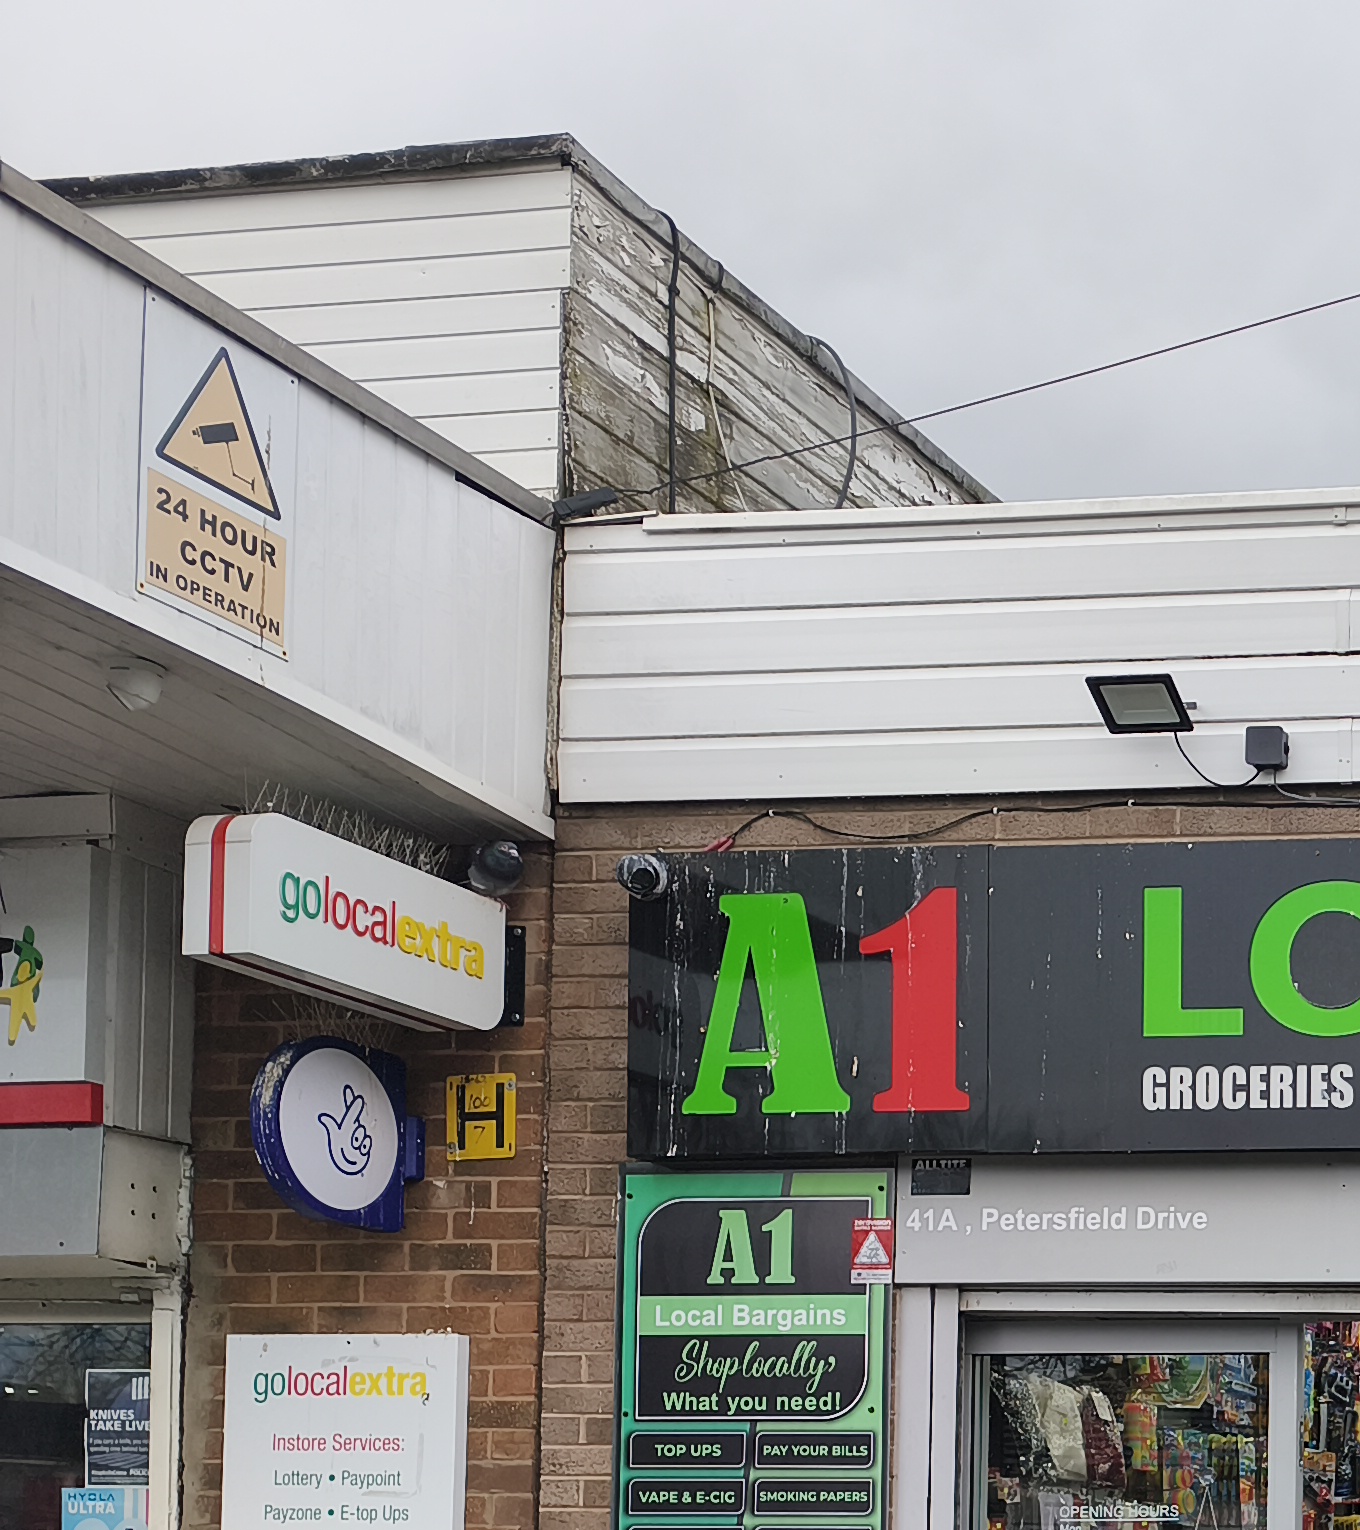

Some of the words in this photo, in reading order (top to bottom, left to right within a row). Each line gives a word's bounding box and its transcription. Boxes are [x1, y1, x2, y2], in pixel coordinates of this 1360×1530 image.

[155, 486, 189, 524] 24
[200, 507, 278, 567] HOUR
[180, 540, 254, 592] CCTV
[149, 561, 168, 584] IN
[175, 573, 281, 636] OPERATION
[279, 869, 486, 980] golocalextra
[682, 886, 971, 1115] A1
[1141, 1063, 1354, 1112] GROCERIES
[982, 1206, 1126, 1232] Petersfield
[1136, 1206, 1208, 1231] Drive
[706, 1208, 796, 1284] A1
[655, 1304, 723, 1327] Local
[732, 1303, 846, 1331] Bargains
[254, 1365, 427, 1403] golocalextra
[663, 1391, 719, 1411] What
[727, 1396, 767, 1415] you
[776, 1391, 841, 1411] need!
[89, 1409, 135, 1420] KNIVES
[90, 1420, 122, 1431] TAKE
[273, 1434, 327, 1451] Instore
[332, 1434, 405, 1452] Services:
[655, 1444, 686, 1457] TOP
[691, 1444, 722, 1457] UPS
[763, 1445, 788, 1456] PAY
[792, 1445, 828, 1457] YOUR
[831, 1446, 868, 1457] BILLS
[274, 1470, 322, 1489] Lottery
[341, 1470, 401, 1489] Paypoint
[639, 1491, 678, 1503] VAPE
[682, 1491, 692, 1503] &
[696, 1491, 735, 1504] E-CIG
[759, 1491, 816, 1502] SMOKING
[820, 1491, 868, 1502] PAPERS
[67, 1501, 115, 1514] ULTRA
[264, 1505, 322, 1524] Payzone
[340, 1505, 377, 1524] E-top
[383, 1505, 409, 1524] Ups
[1060, 1505, 1124, 1518] OPENING
[1130, 1504, 1179, 1517] HOURS
